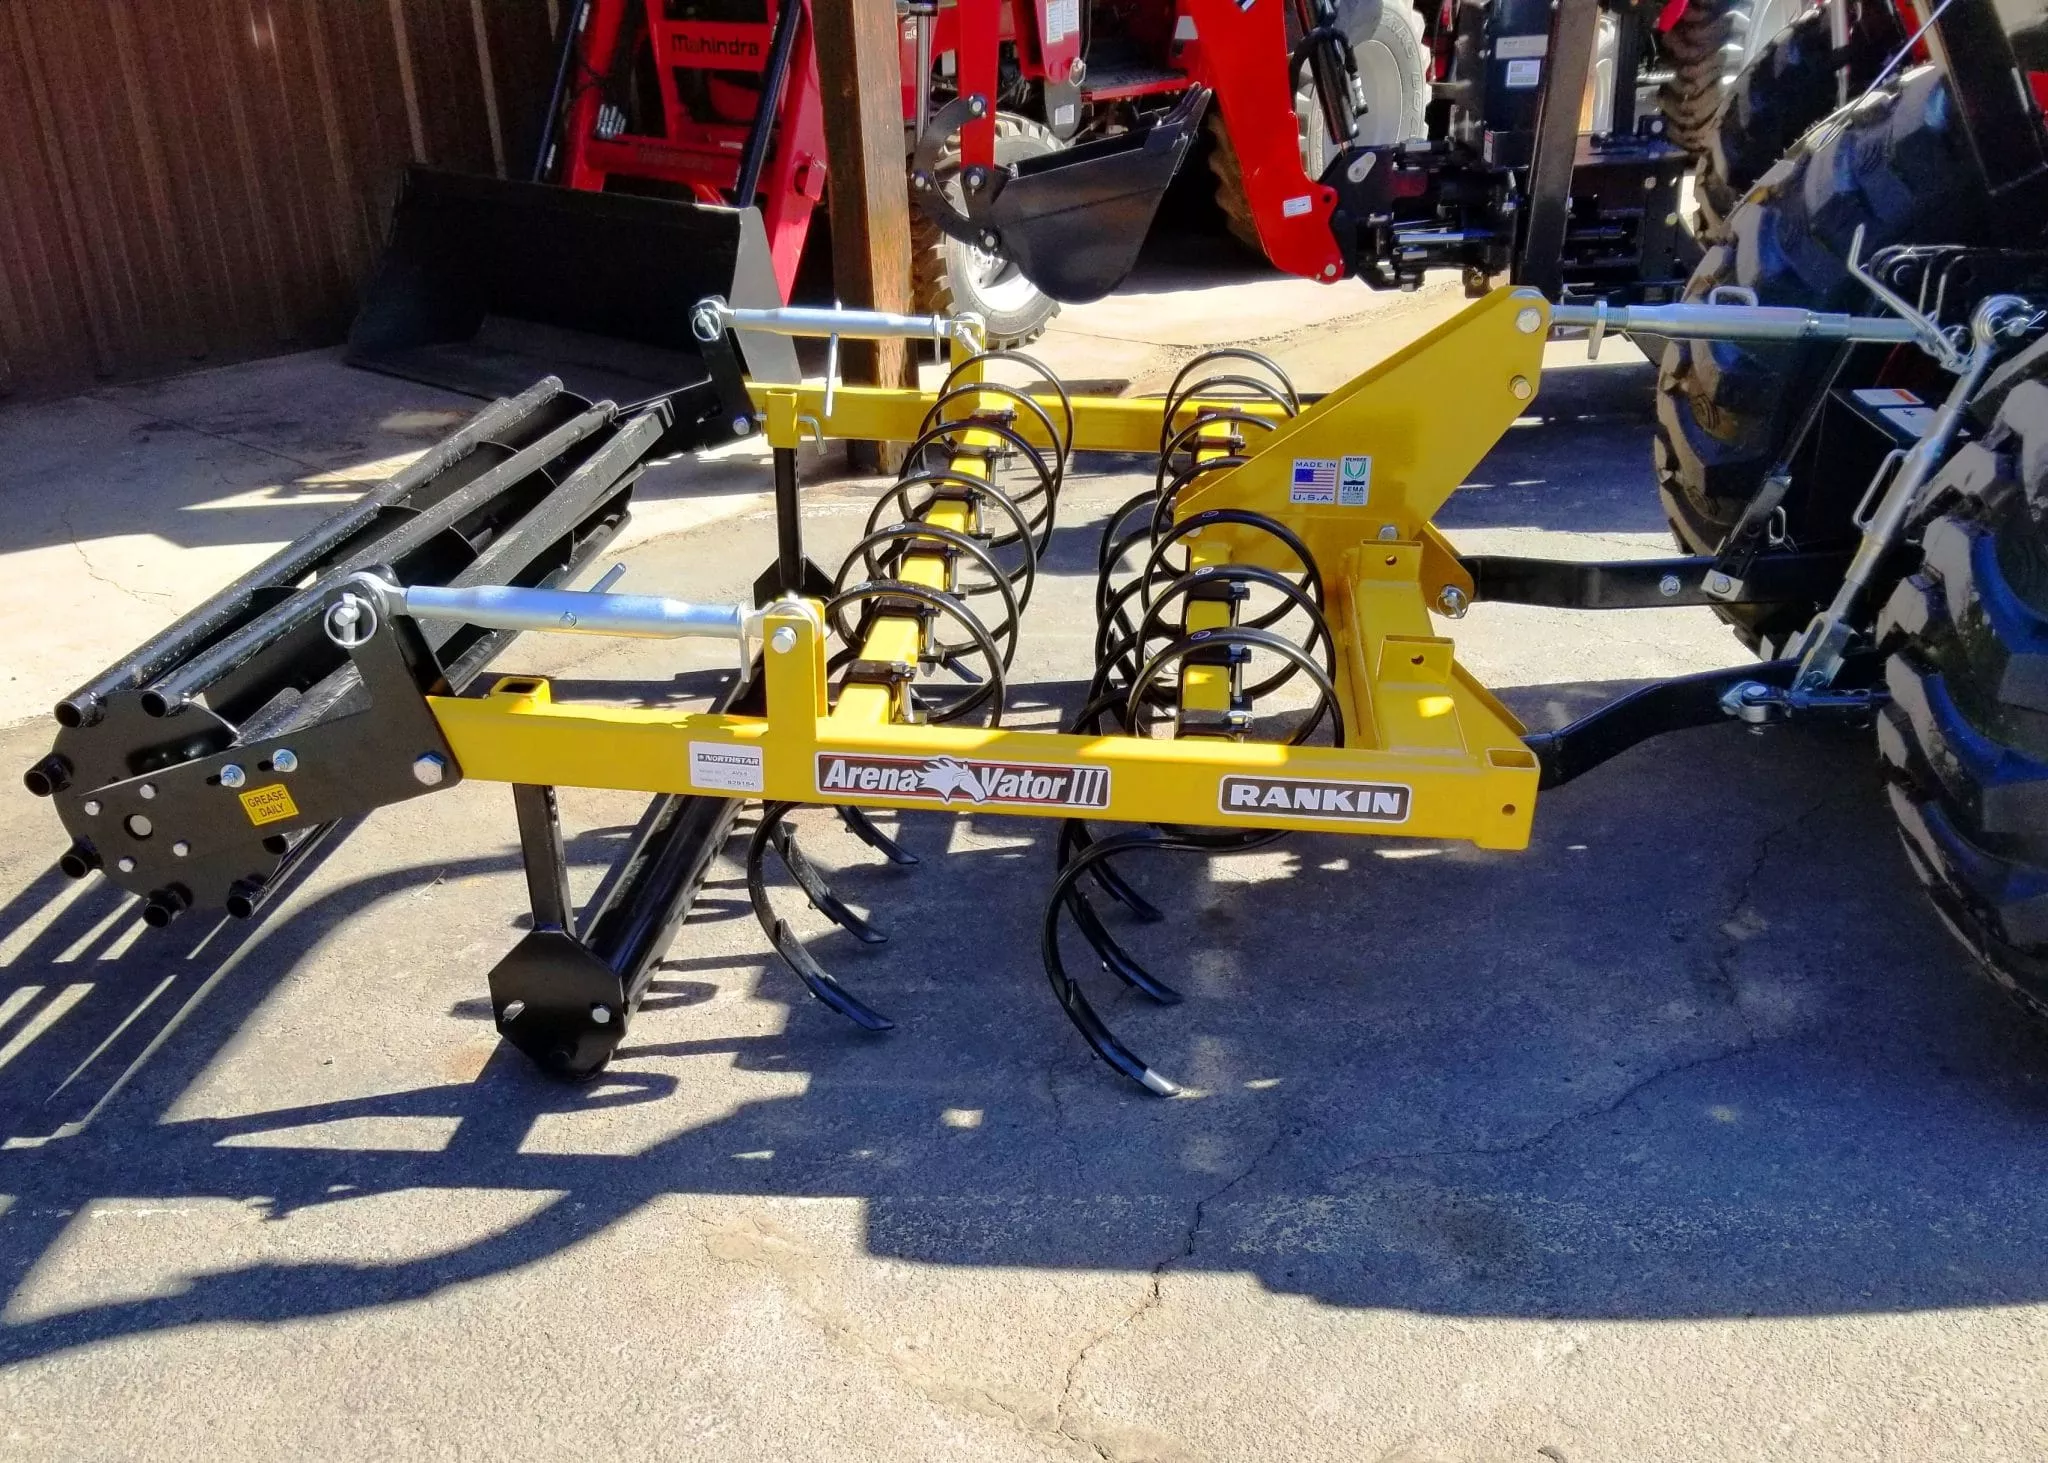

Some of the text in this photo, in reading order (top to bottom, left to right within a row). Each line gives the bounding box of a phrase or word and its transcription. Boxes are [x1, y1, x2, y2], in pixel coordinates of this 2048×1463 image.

[672, 33, 759, 57] Mahindra
[705, 755, 759, 766] NORTHSTAR
[823, 760, 919, 794] Arena
[980, 766, 1066, 800] Vator
[247, 790, 286, 808] GREASE
[1229, 784, 1401, 815] RANKIN
[259, 802, 286, 818] DAILY
